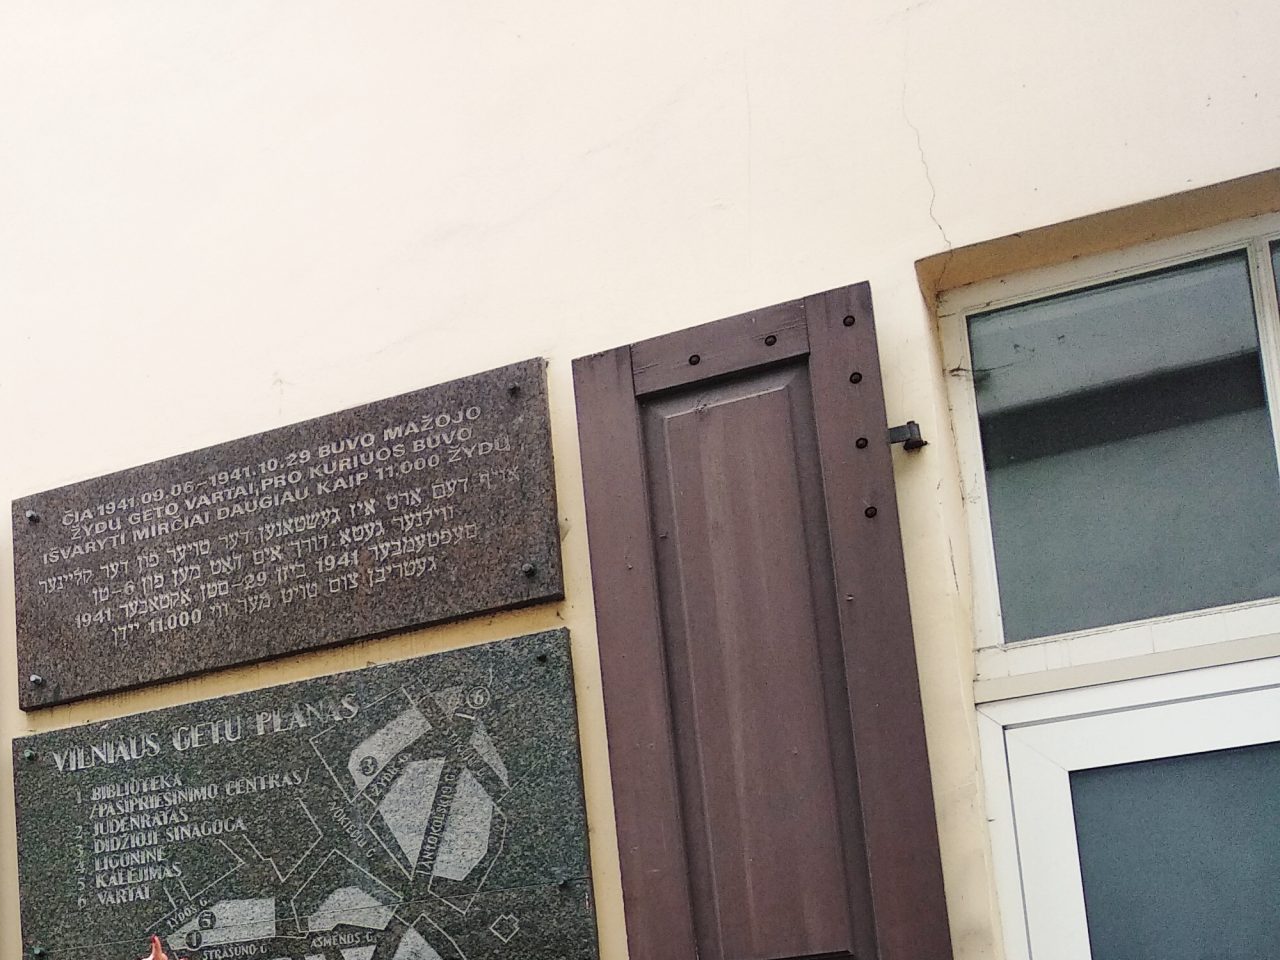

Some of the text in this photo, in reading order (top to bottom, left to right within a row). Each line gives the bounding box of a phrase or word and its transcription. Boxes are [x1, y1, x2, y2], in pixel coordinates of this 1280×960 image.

[319, 433, 375, 459] BUVO
[383, 406, 481, 441] MAŽOJO
[128, 502, 180, 526] GETO
[309, 444, 406, 480] KURIUOS
[413, 427, 471, 453] BUVO
[43, 534, 126, 565] IŠVARYTI
[217, 486, 310, 521] DAUGIAU
[317, 471, 369, 497] KAIP
[316, 549, 359, 573] 1941
[74, 607, 112, 629] 1941
[52, 732, 161, 773] VILNIAUS
[256, 693, 360, 736] PLANAS
[91, 773, 183, 801] BIBLIOTEKA
[93, 807, 189, 837] JUDENRATAS
[166, 816, 248, 843] SINAGOGA
[97, 884, 151, 905] VARTAI
[166, 904, 197, 929] LYDOS
